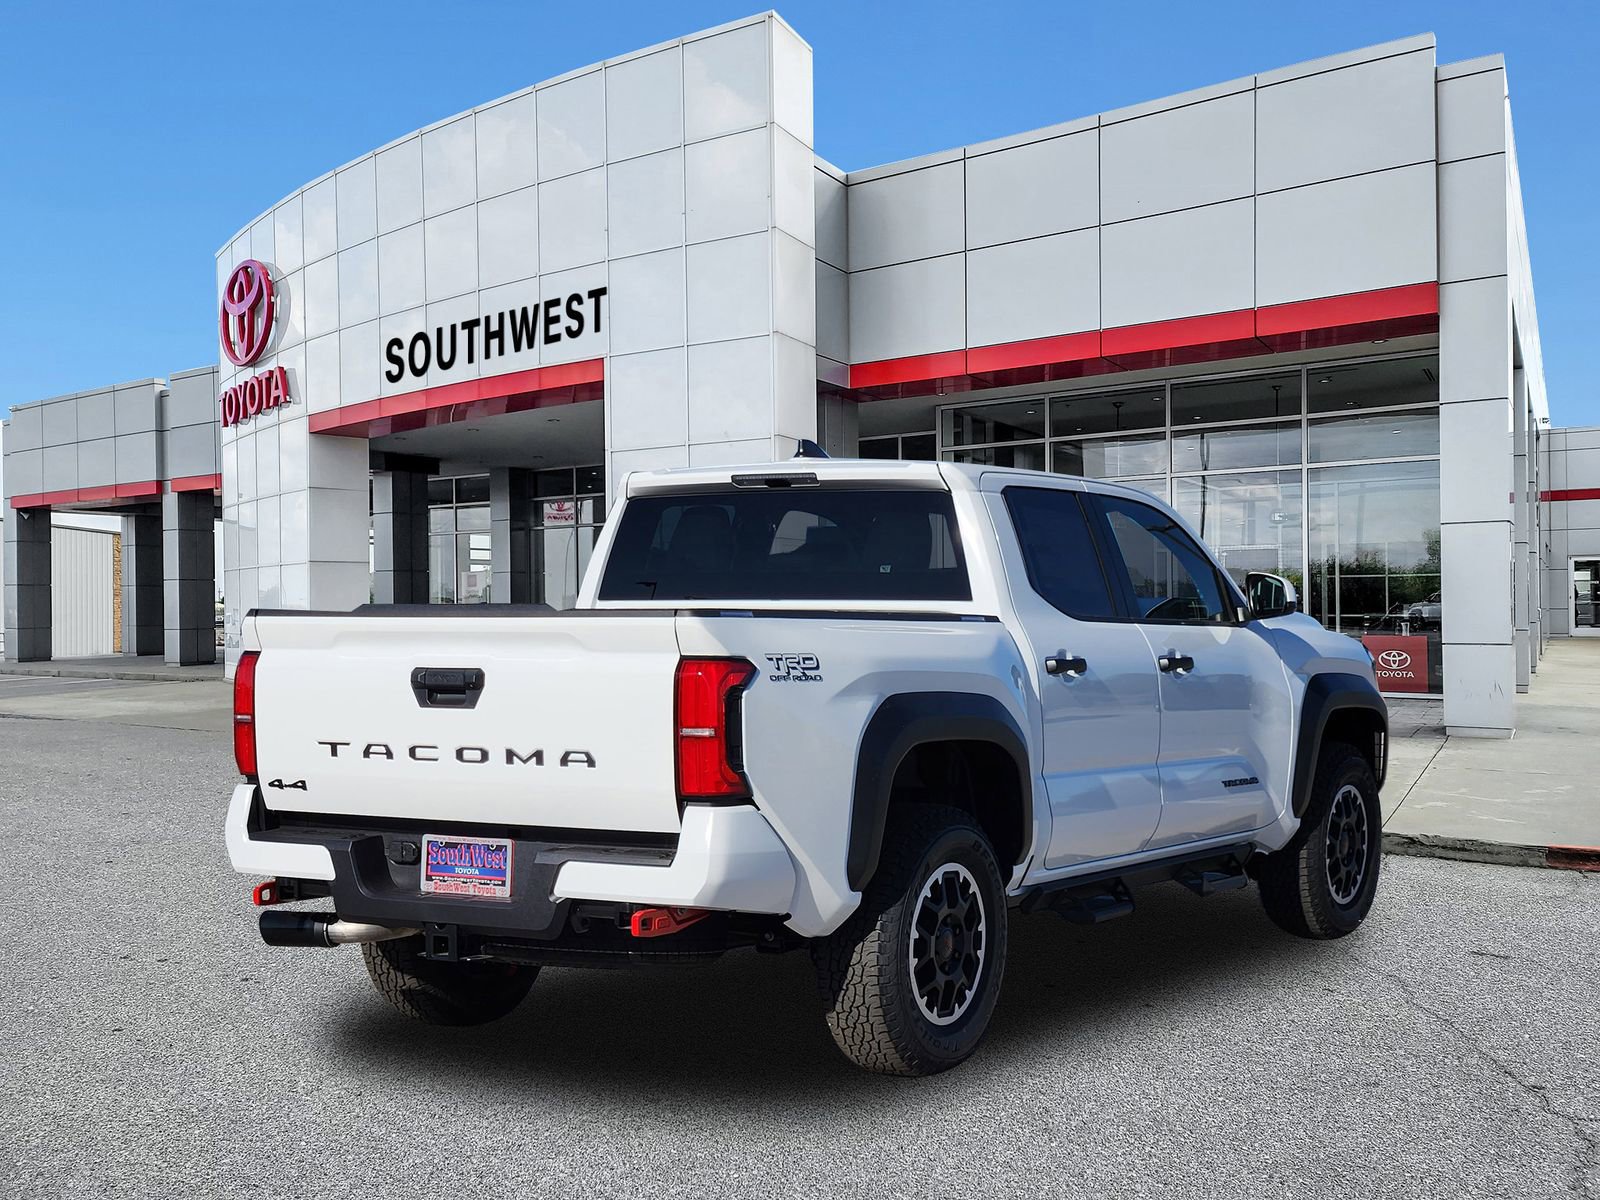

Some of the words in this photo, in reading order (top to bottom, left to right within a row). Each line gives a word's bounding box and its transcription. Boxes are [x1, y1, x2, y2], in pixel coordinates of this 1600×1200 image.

[385, 286, 608, 384] SOUTHWEST
[217, 366, 291, 428] TOYOTA
[764, 653, 820, 676] TRD
[1376, 670, 1415, 678] TOYOTA
[792, 674, 824, 682] ROAD
[317, 741, 597, 768] TACOMA
[428, 842, 507, 870] SouthWest
[455, 867, 479, 875] TOYOTA
[434, 882, 470, 893] SouthWest
[472, 884, 496, 895] Toyota
